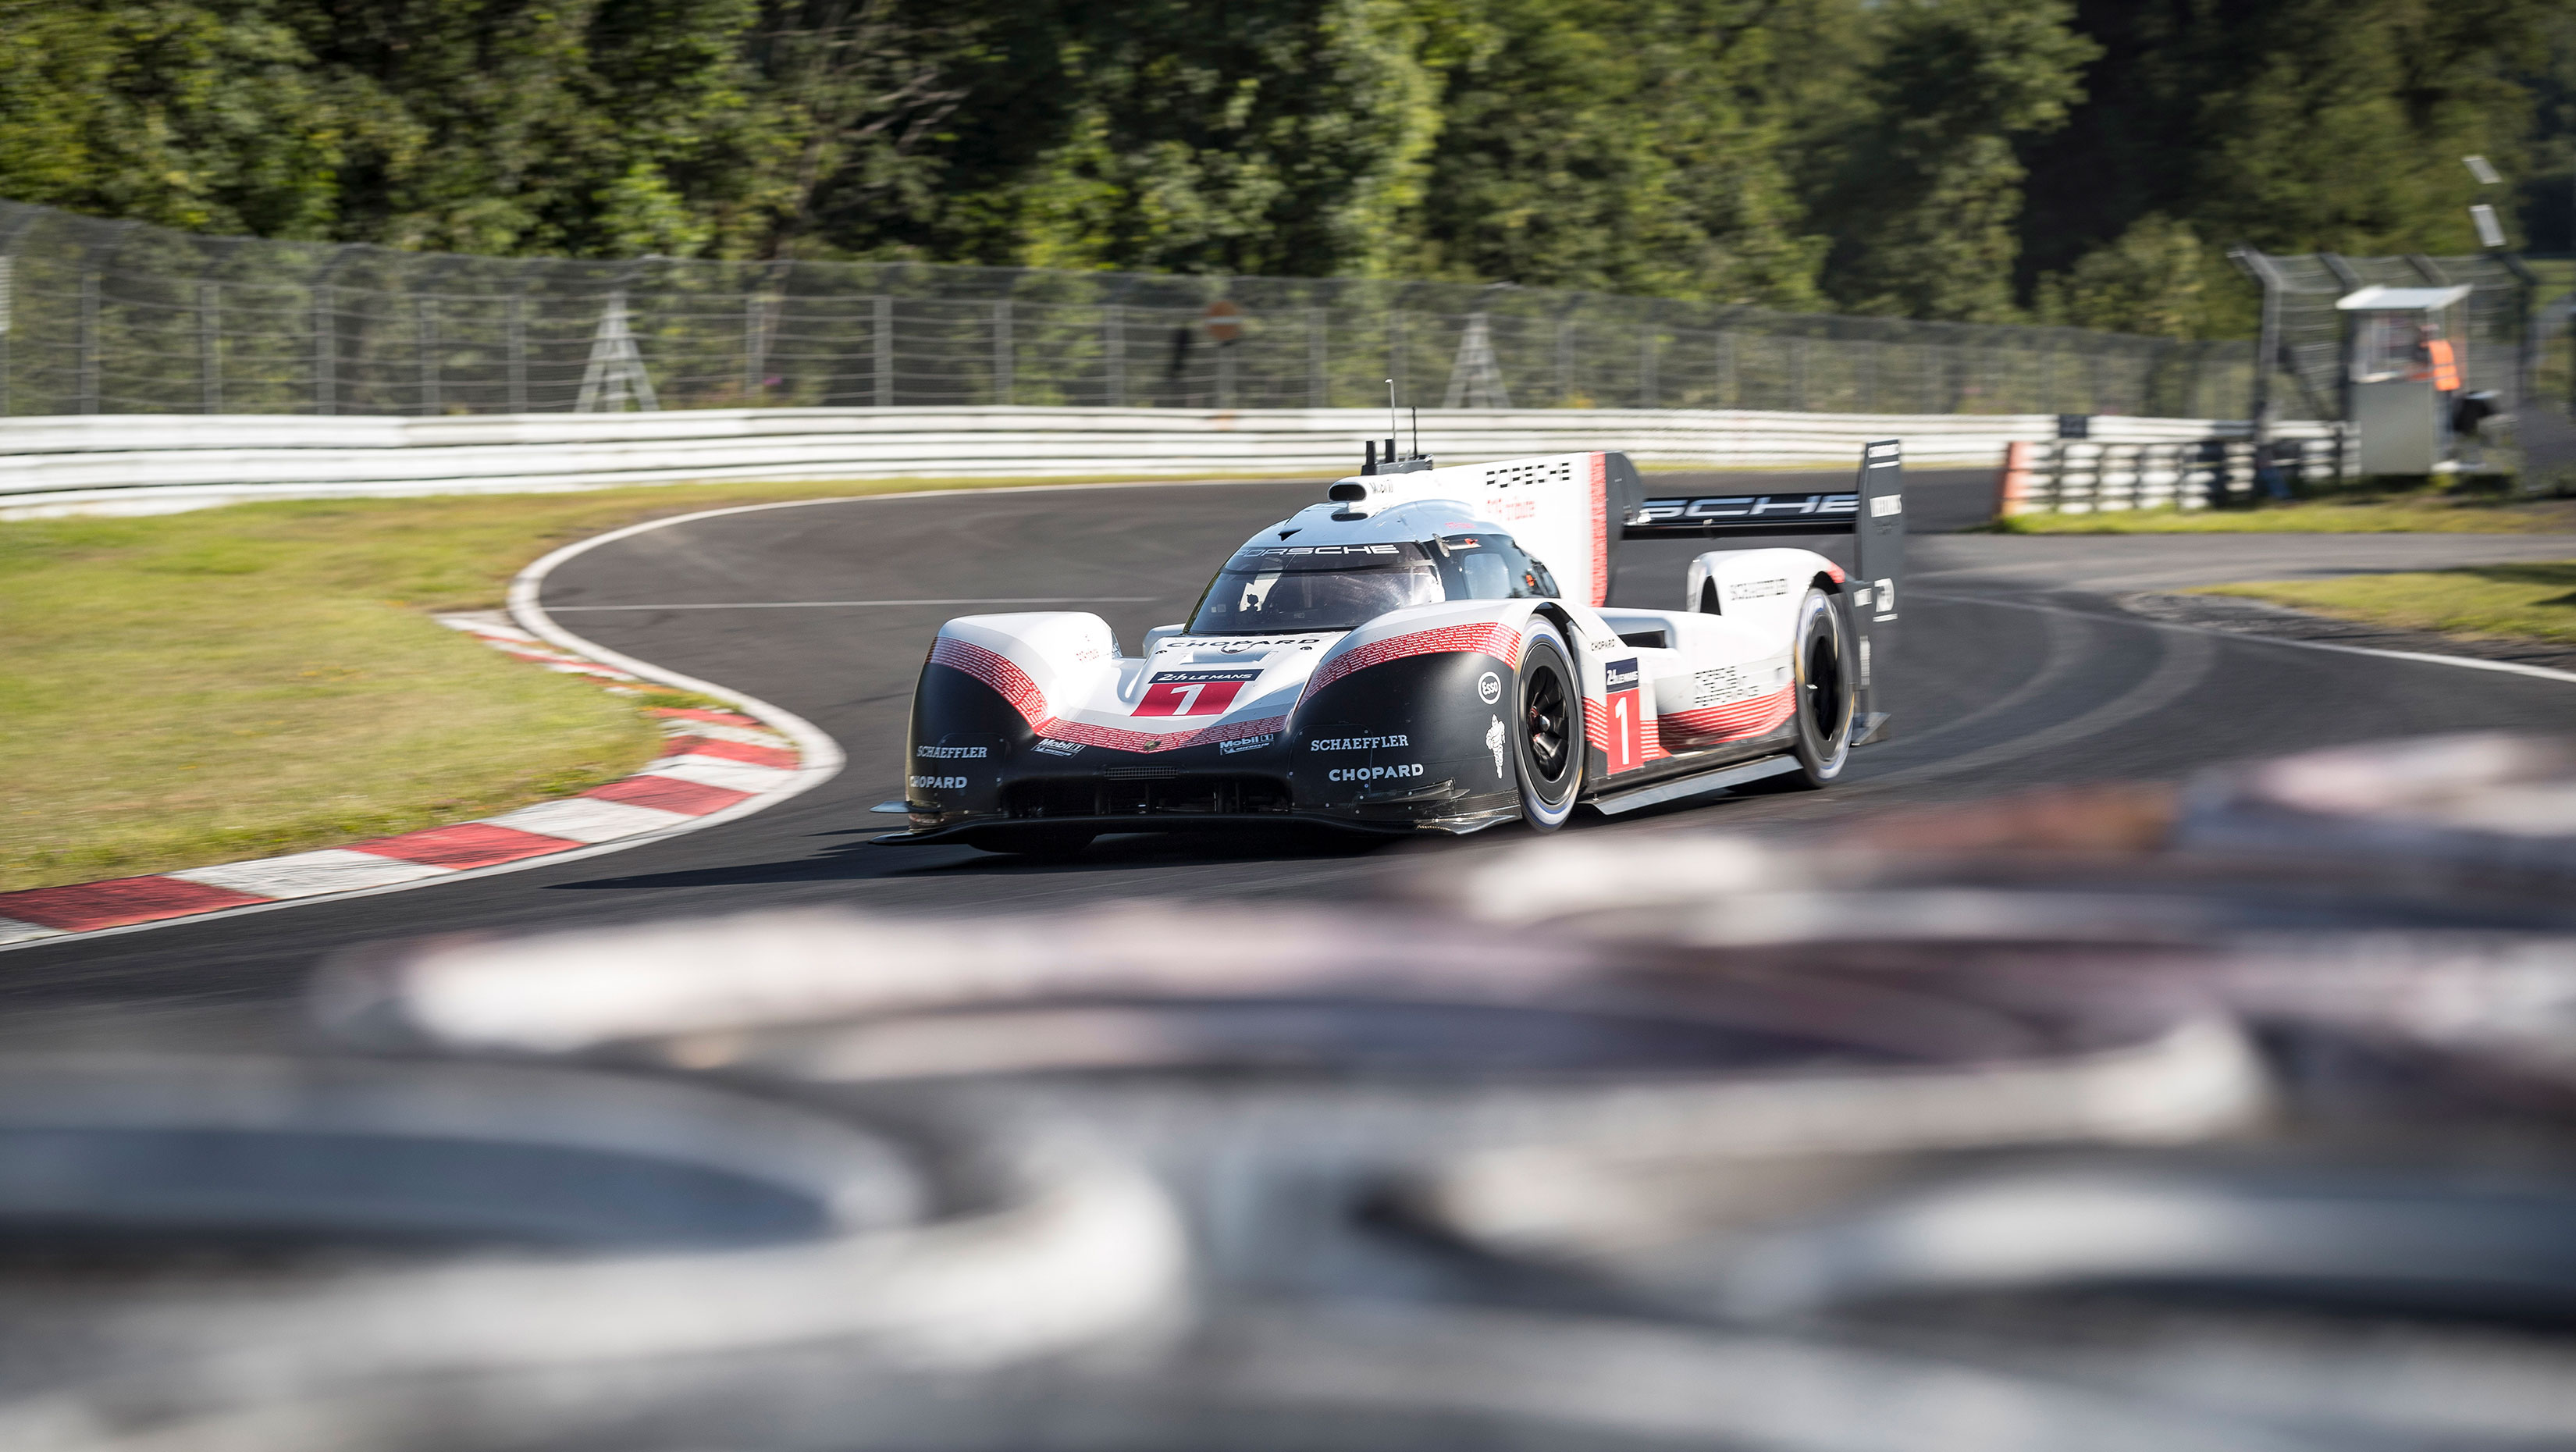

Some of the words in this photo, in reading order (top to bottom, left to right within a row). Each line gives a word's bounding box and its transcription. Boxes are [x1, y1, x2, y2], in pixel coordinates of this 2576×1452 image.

[1485, 462, 1572, 489] PORSCHE
[1642, 494, 1859, 518] SCHE
[1166, 639, 1320, 648] CHOPARD
[1482, 681, 1499, 696] Esso
[1170, 683, 1207, 716] 1
[1615, 696, 1630, 765] 1
[1038, 738, 1076, 750] Mobil
[1219, 736, 1259, 749] Mobil
[1311, 735, 1409, 752] SCHAEFFLER
[916, 746, 987, 759] SCHAEFFLER
[1329, 763, 1424, 781] CHOPARD
